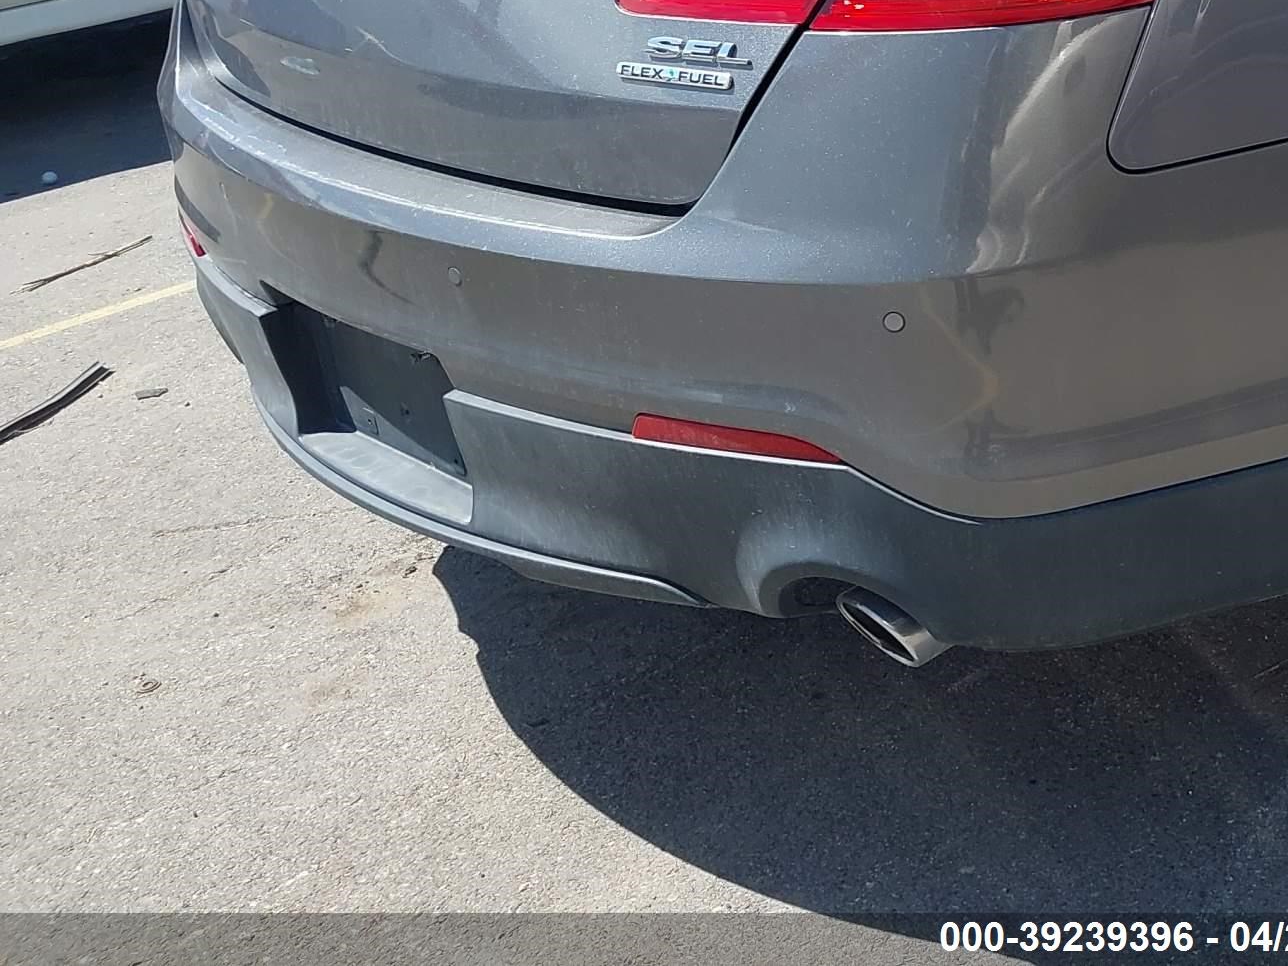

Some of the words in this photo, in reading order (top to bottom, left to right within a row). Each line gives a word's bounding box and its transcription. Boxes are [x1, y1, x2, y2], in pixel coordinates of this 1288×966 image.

[645, 36, 752, 66] SEL
[620, 64, 664, 80] FLEX
[678, 71, 726, 87] FUEL
